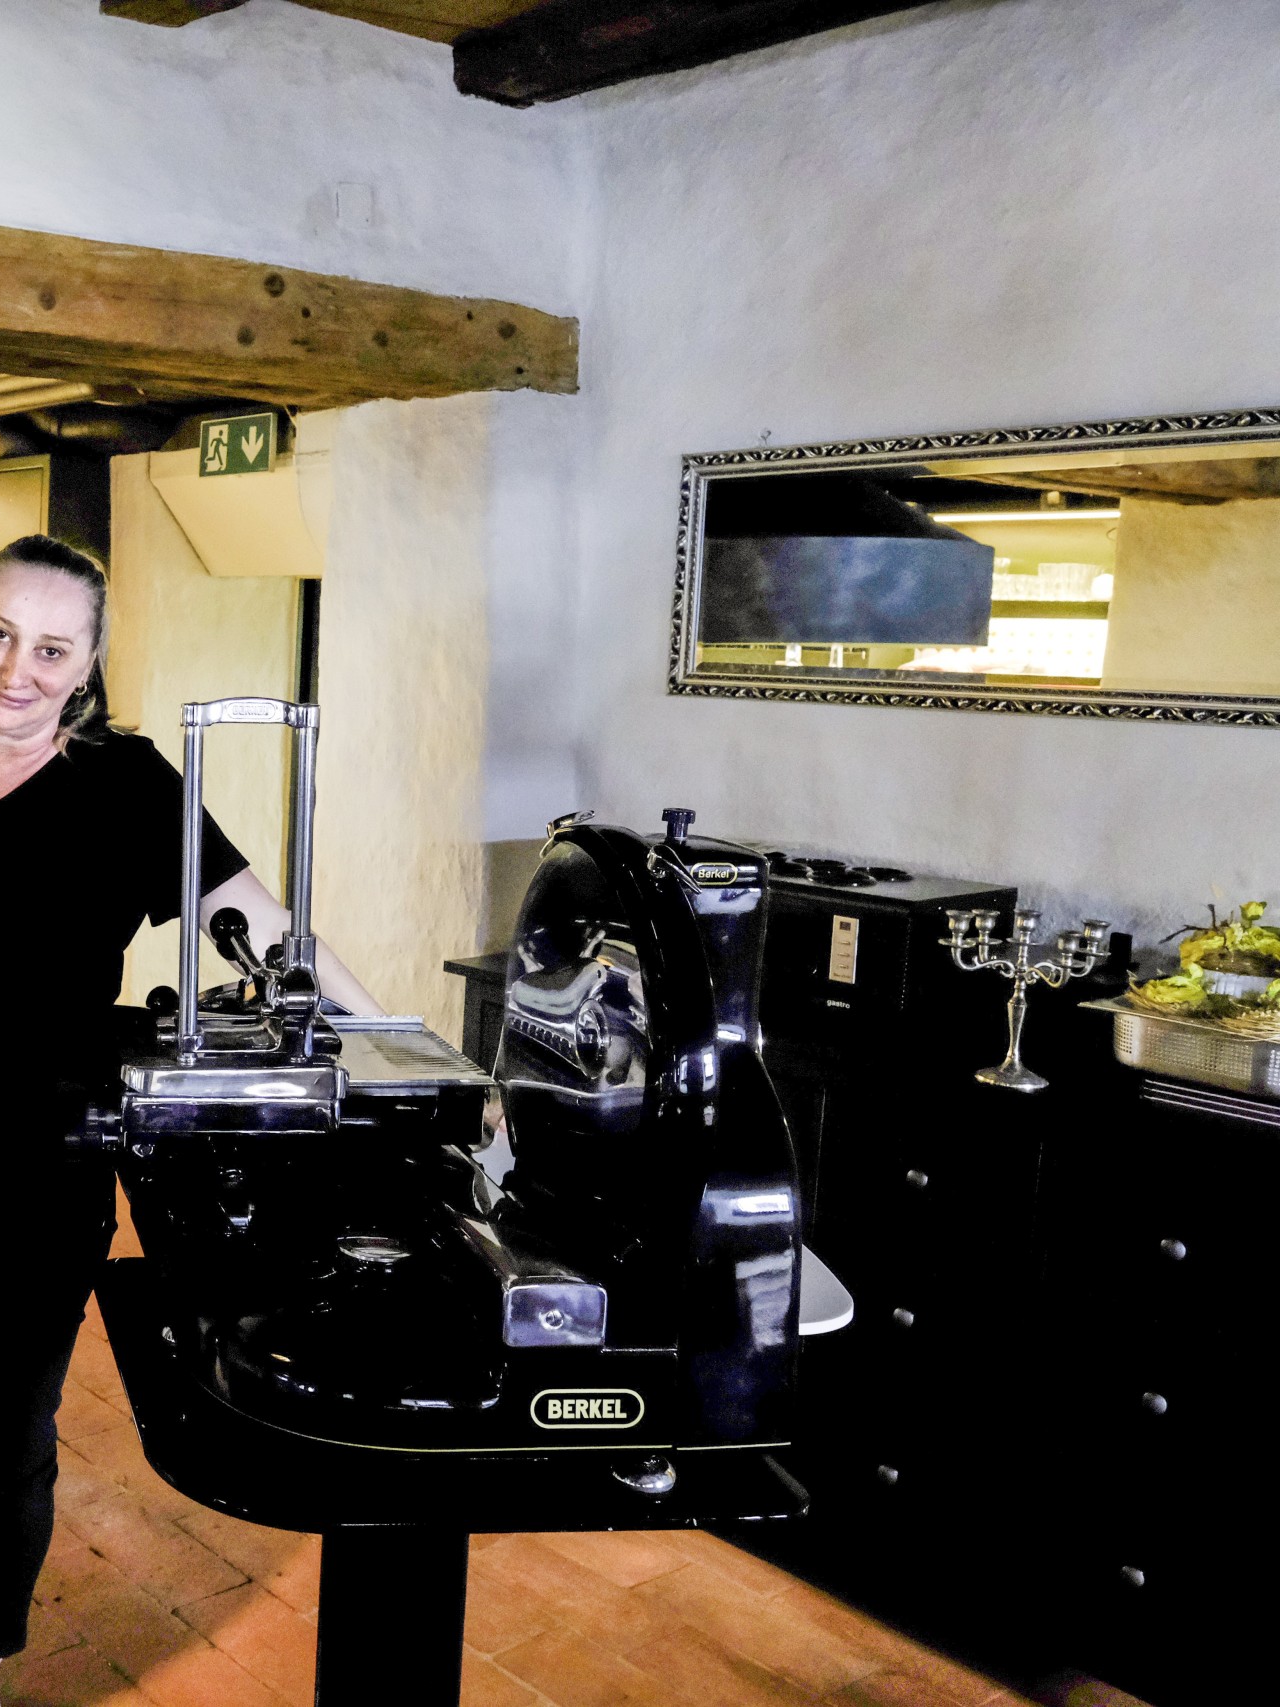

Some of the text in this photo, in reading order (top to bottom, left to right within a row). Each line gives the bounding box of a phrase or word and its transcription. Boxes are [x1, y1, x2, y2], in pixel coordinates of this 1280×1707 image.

[698, 869, 729, 878] Berkel
[826, 999, 850, 1009] gastro
[548, 1399, 627, 1419] BERKEL
